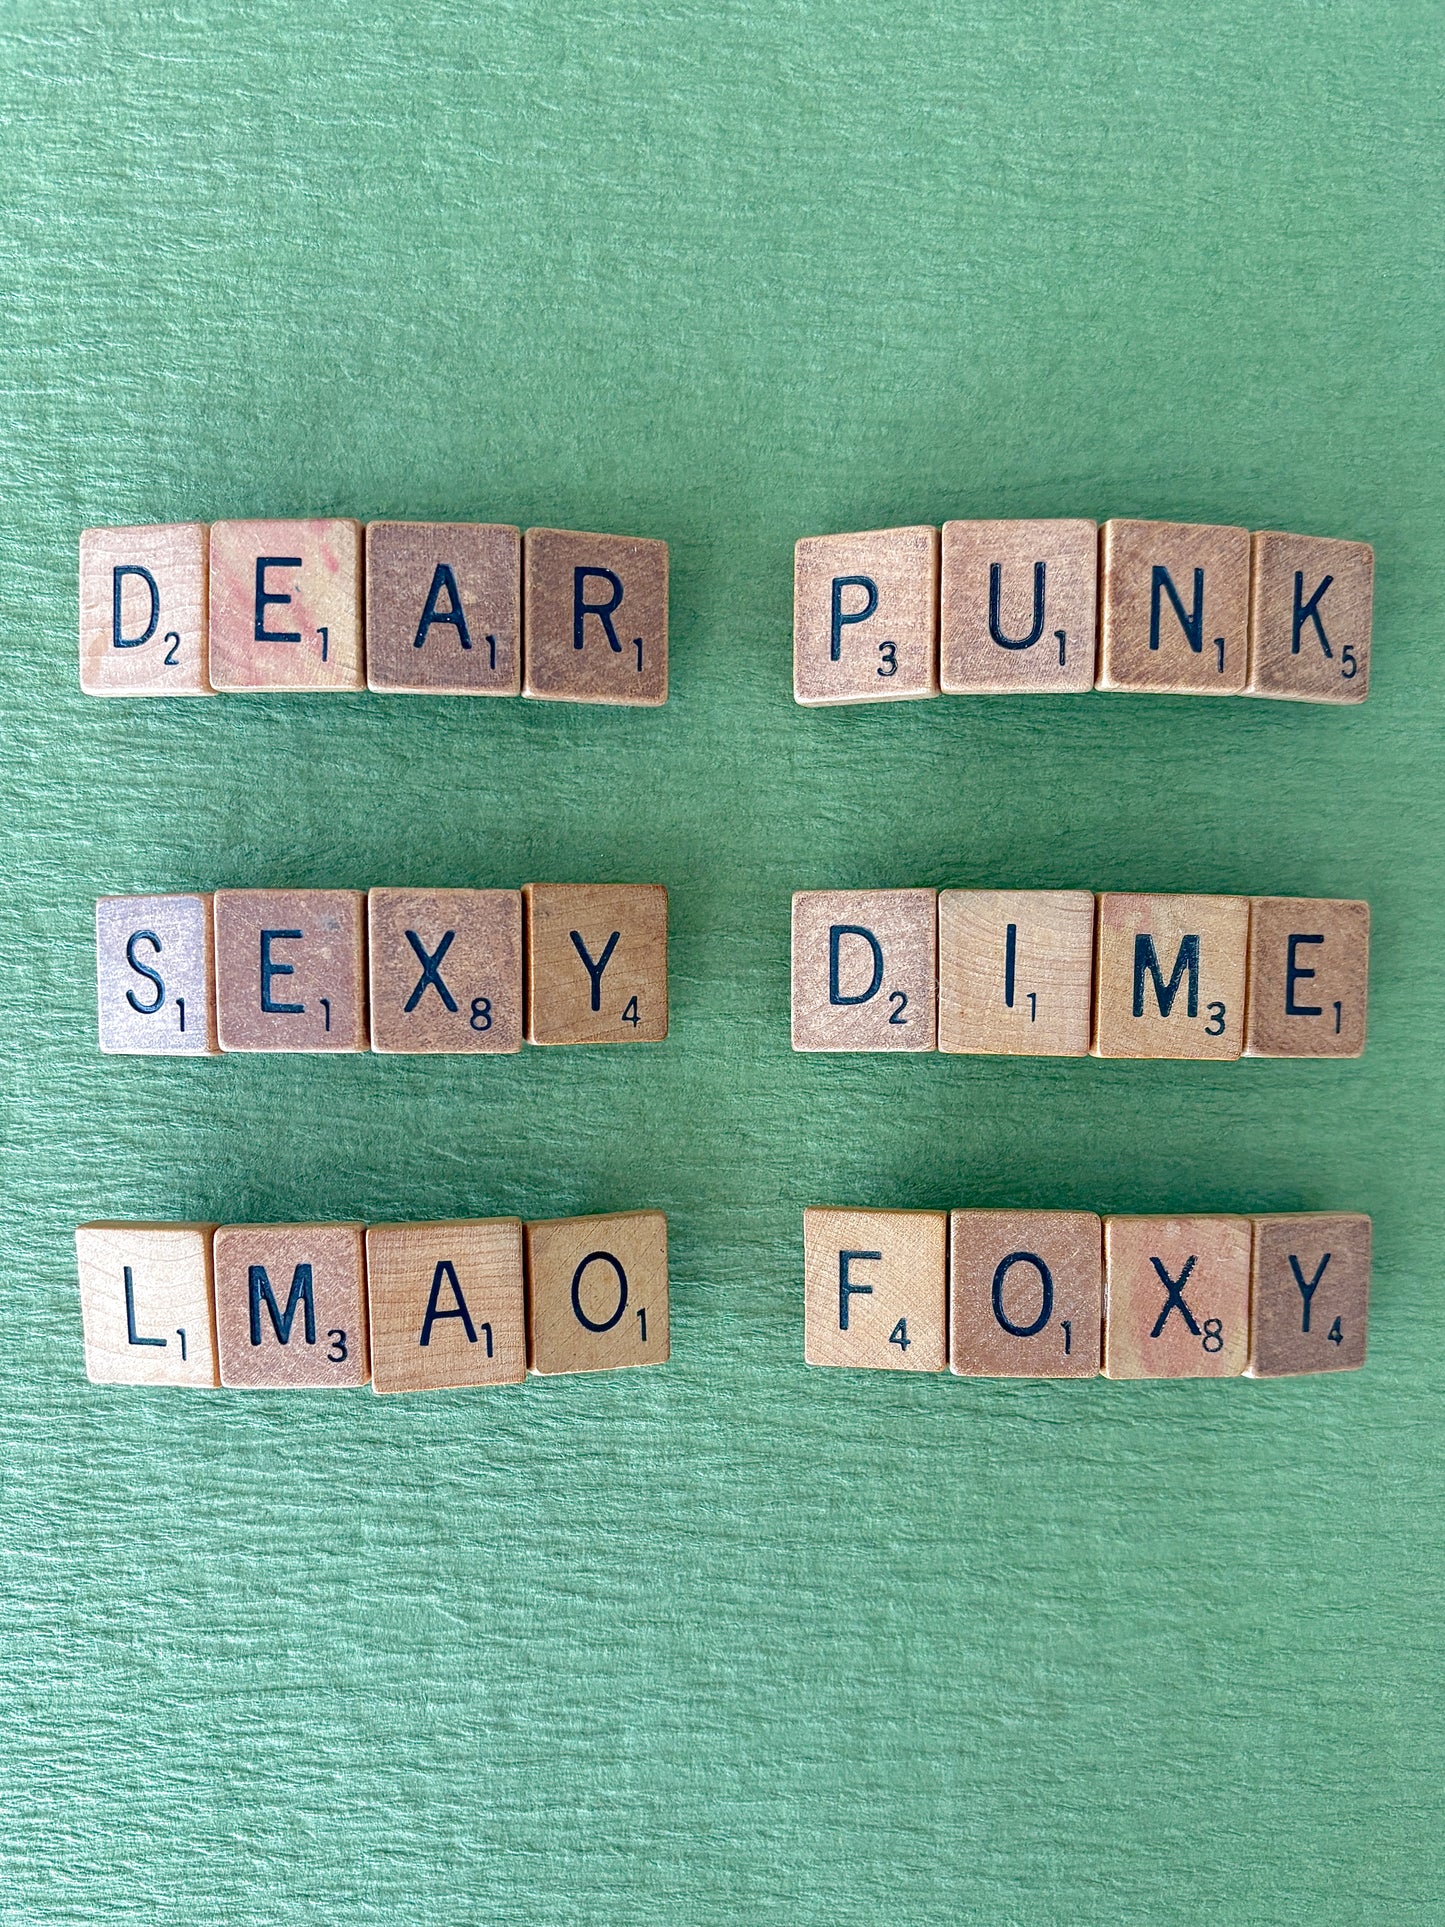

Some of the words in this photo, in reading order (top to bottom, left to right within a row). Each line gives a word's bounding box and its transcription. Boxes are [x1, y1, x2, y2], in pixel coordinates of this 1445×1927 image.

[113, 556, 624, 654] DEAR
[830, 561, 1335, 662] PUNK
[163, 631, 180, 666] 2
[316, 627, 330, 662] 1
[485, 634, 497, 671] 1
[632, 637, 643, 673] 1
[877, 640, 899, 677] 3
[1053, 629, 1067, 667] 1
[1213, 637, 1226, 674] 1
[1341, 644, 1358, 679] 5
[125, 929, 621, 1015] SEXY
[829, 923, 1325, 1018] DIME
[175, 997, 186, 1032] 1
[320, 998, 331, 1032] 1
[469, 996, 493, 1032] 8
[621, 995, 642, 1028] 4
[888, 991, 908, 1025] 2
[1026, 992, 1037, 1023] 1
[1204, 1001, 1227, 1036] 3
[1333, 1000, 1342, 1035] 1
[123, 1250, 629, 1348] LMAO
[838, 1250, 1331, 1338] FOXY
[176, 1328, 187, 1361] 1
[326, 1329, 348, 1363] 3
[480, 1322, 494, 1358] 1
[636, 1307, 648, 1342] 1
[888, 1318, 911, 1352] 4
[1060, 1320, 1072, 1355] 1
[1202, 1318, 1224, 1353] 8
[1327, 1315, 1344, 1347] 4
